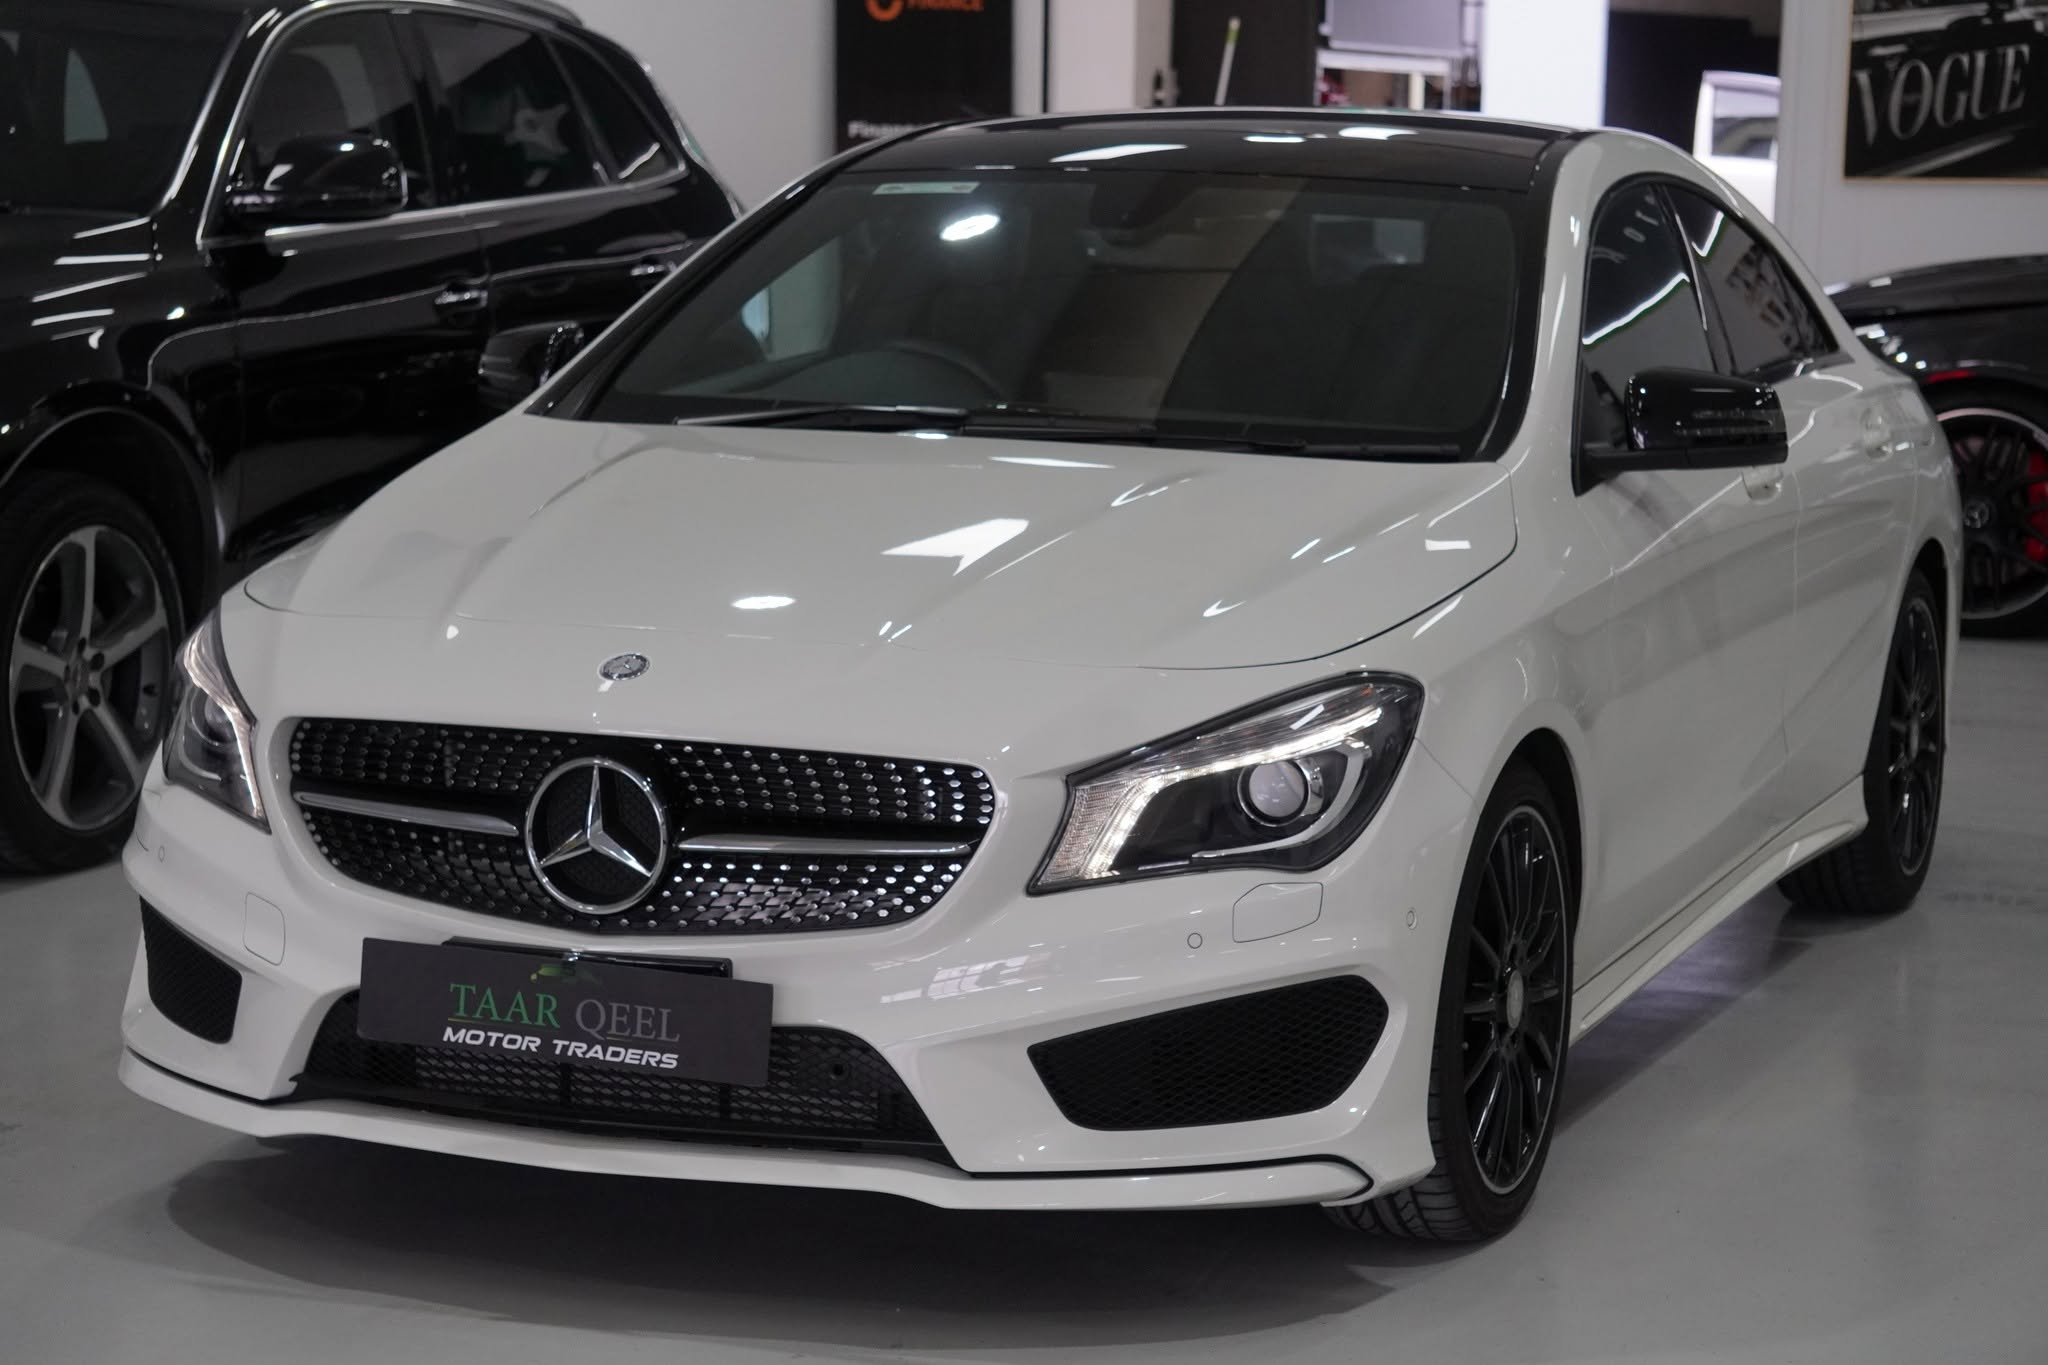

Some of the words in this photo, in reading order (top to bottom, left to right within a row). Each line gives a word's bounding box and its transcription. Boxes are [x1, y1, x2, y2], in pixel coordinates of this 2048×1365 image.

[1855, 43, 2030, 147] VOGUE
[449, 983, 561, 1028] TAAR
[575, 999, 681, 1042] QEEL
[442, 1026, 541, 1052] MOTOR
[552, 1039, 679, 1069] TRADERS
